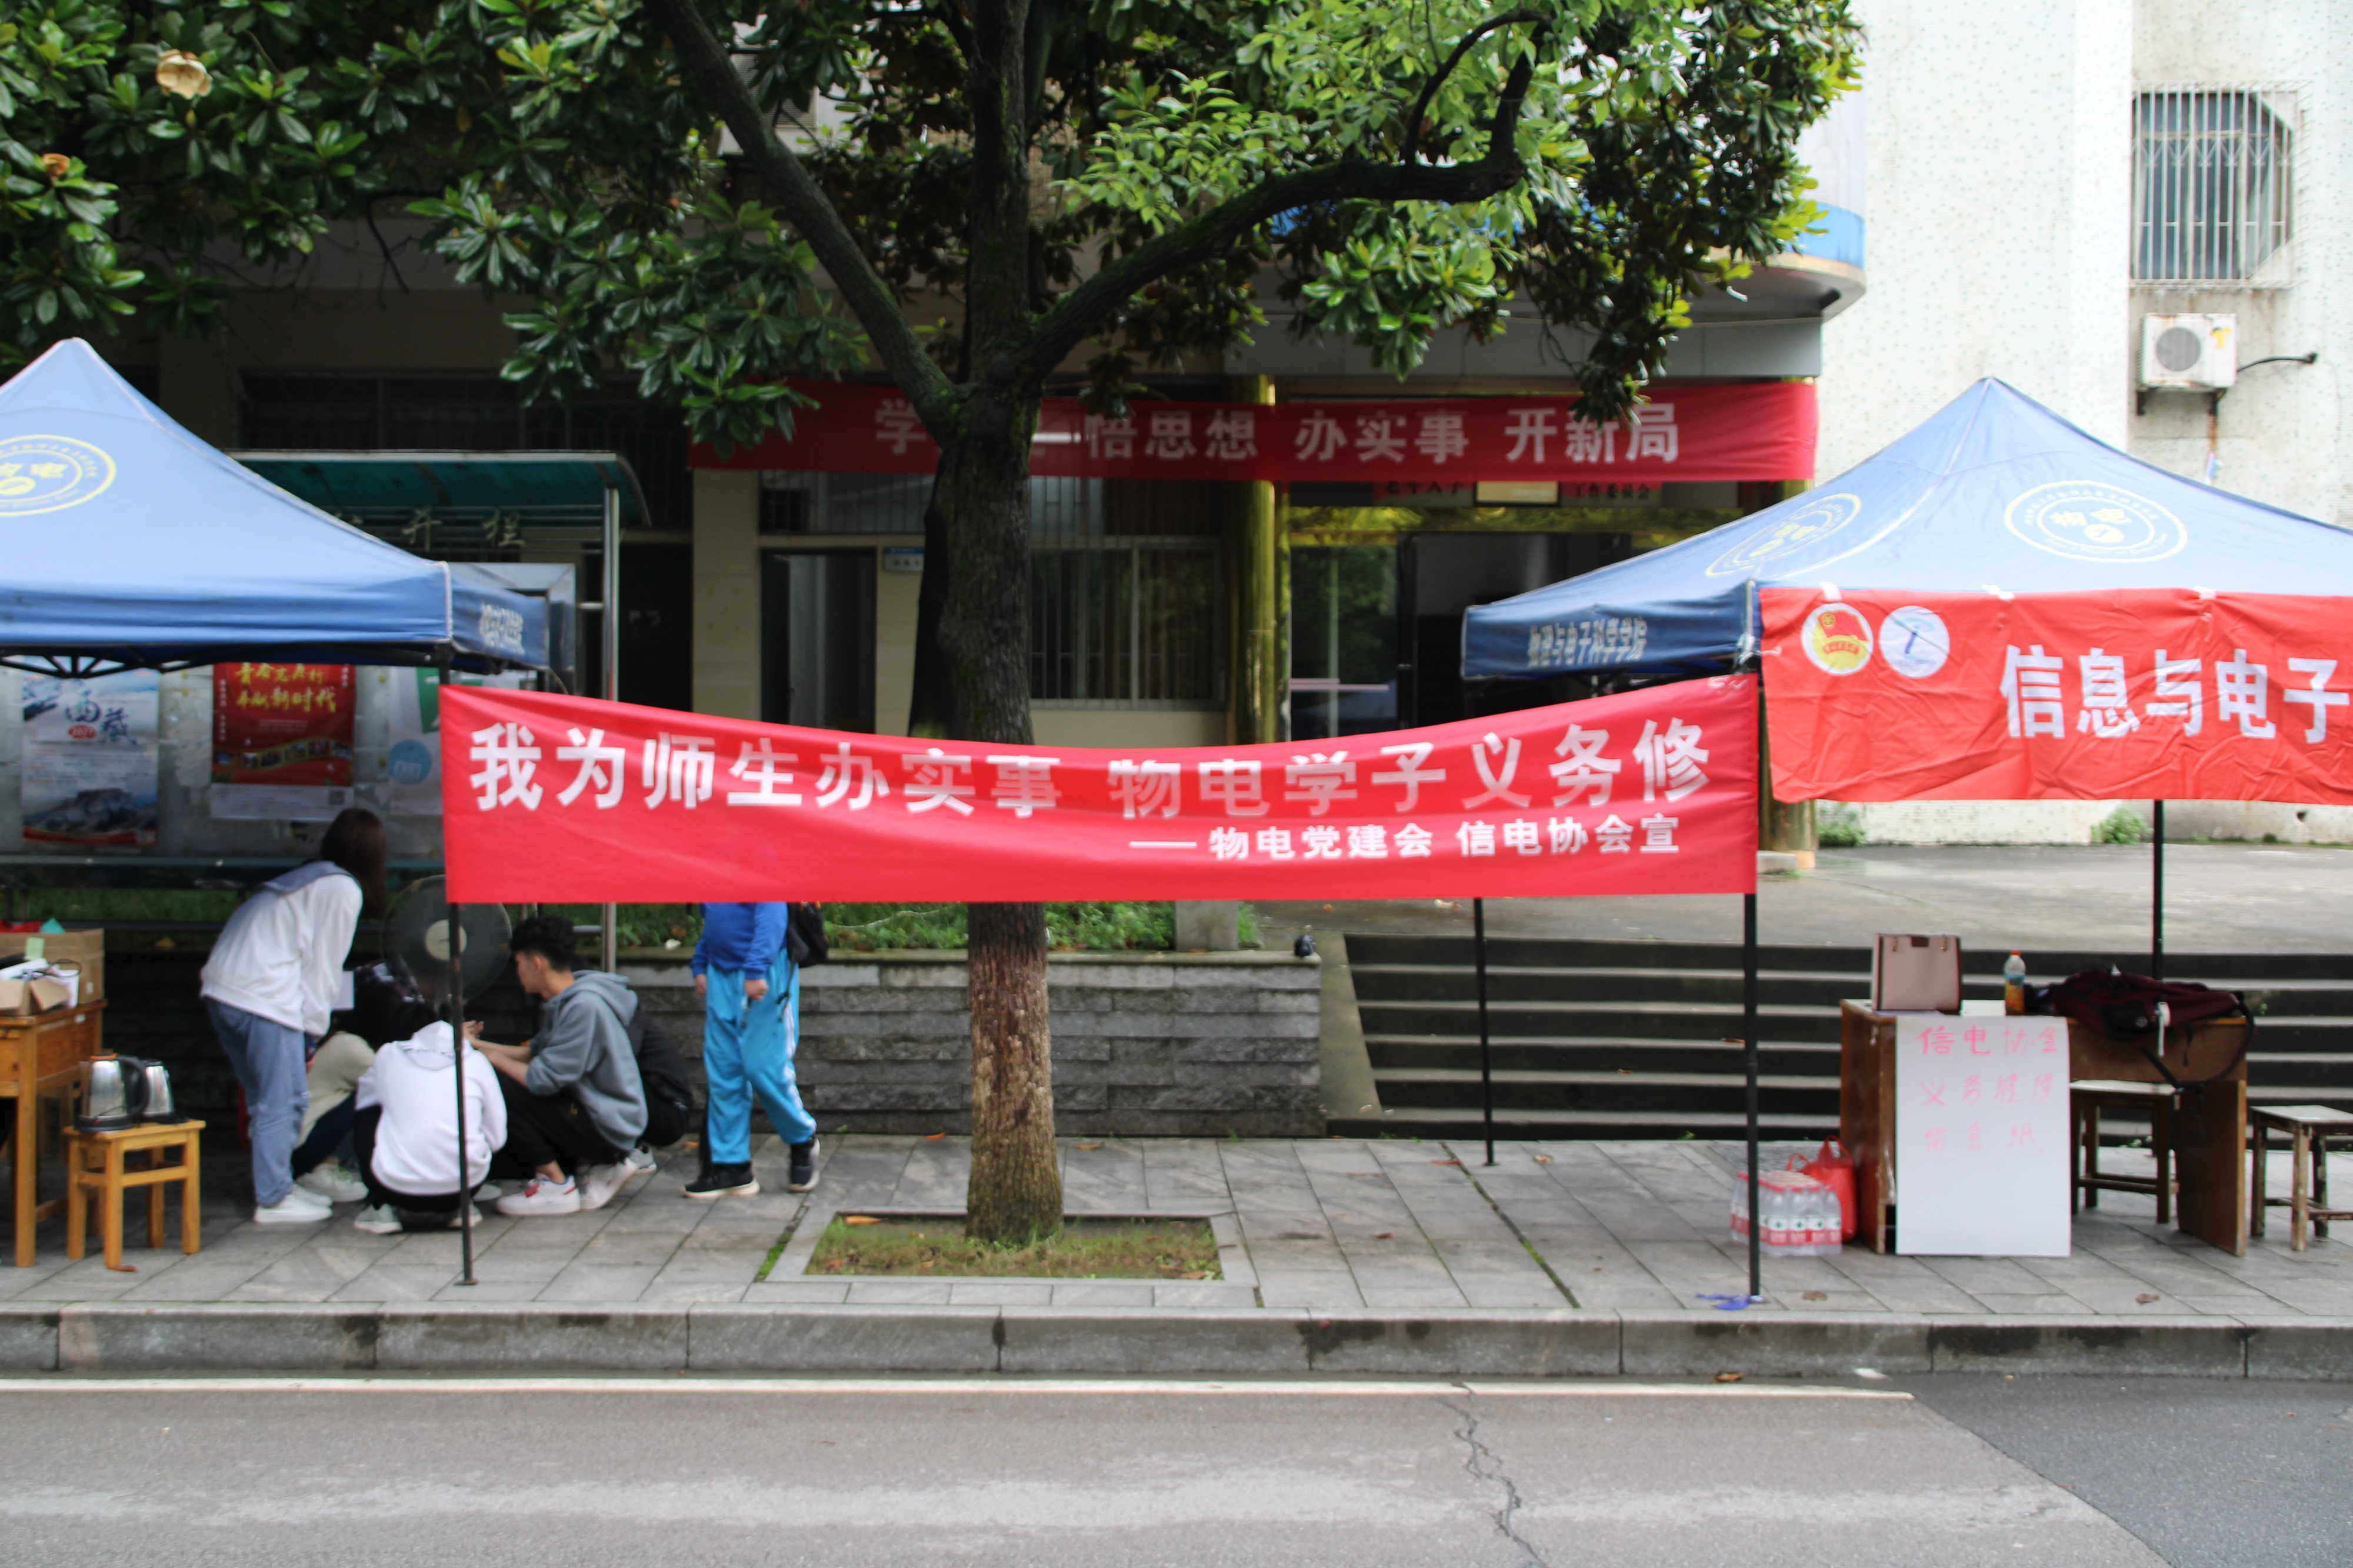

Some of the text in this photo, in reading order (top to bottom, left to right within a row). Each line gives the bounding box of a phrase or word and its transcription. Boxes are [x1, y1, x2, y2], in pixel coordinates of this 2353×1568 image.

[1084, 410, 1258, 460] 悟思想
[1294, 410, 1469, 465] 办实事
[1504, 403, 1679, 464] 开新局
[1998, 643, 2351, 745] 信息与电子
[469, 717, 1711, 819] 我为师生办实事 物电学子义务修
[1455, 813, 1681, 857] 信电协会宣
[1914, 1025, 2059, 1056] 信电协会
